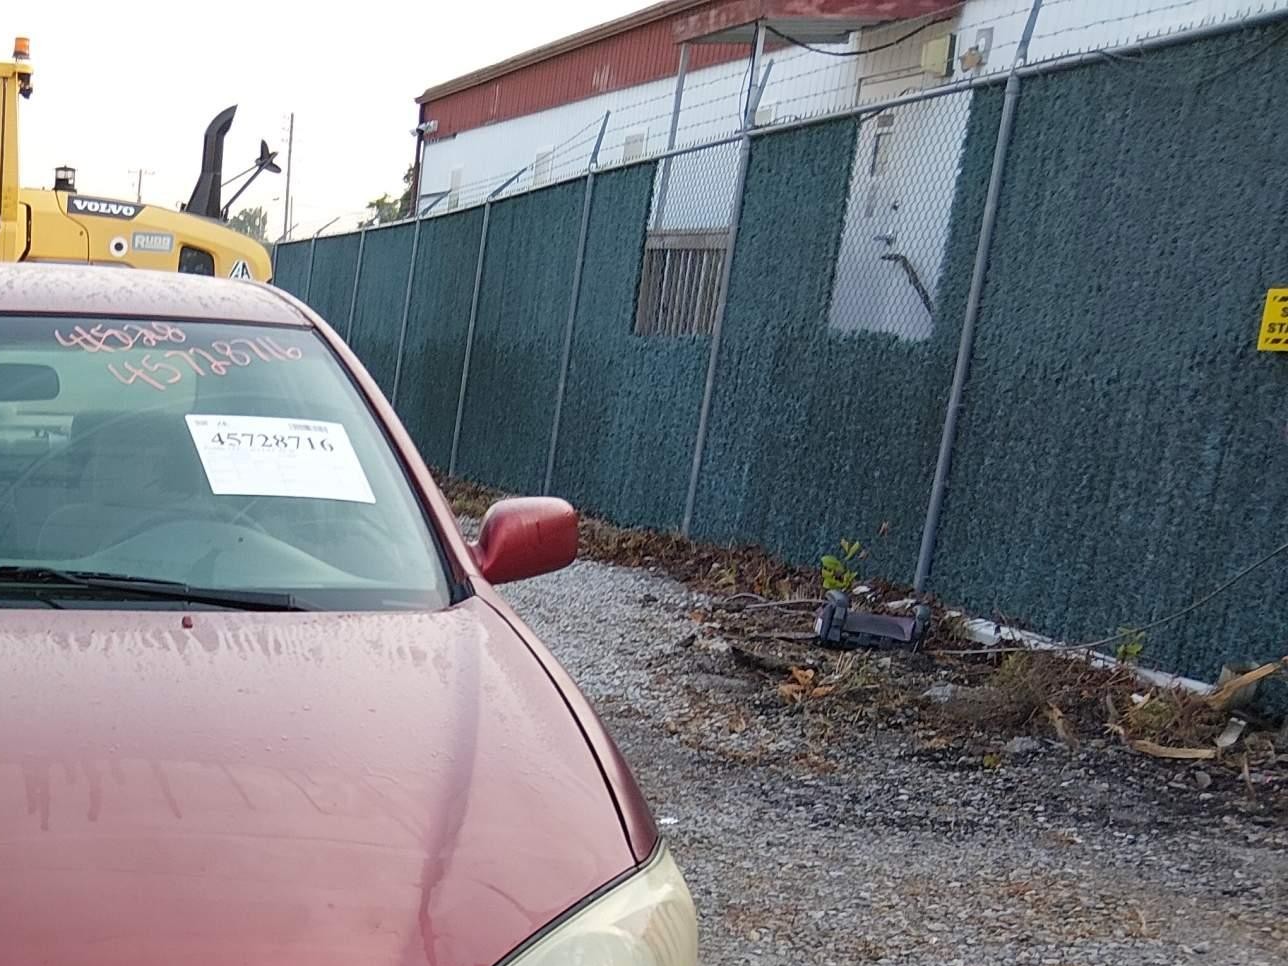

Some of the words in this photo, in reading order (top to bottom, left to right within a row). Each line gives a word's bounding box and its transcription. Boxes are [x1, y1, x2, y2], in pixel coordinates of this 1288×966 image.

[73, 199, 135, 217] VOLVO
[108, 336, 302, 390] 45728716
[211, 432, 335, 452] 45728716
